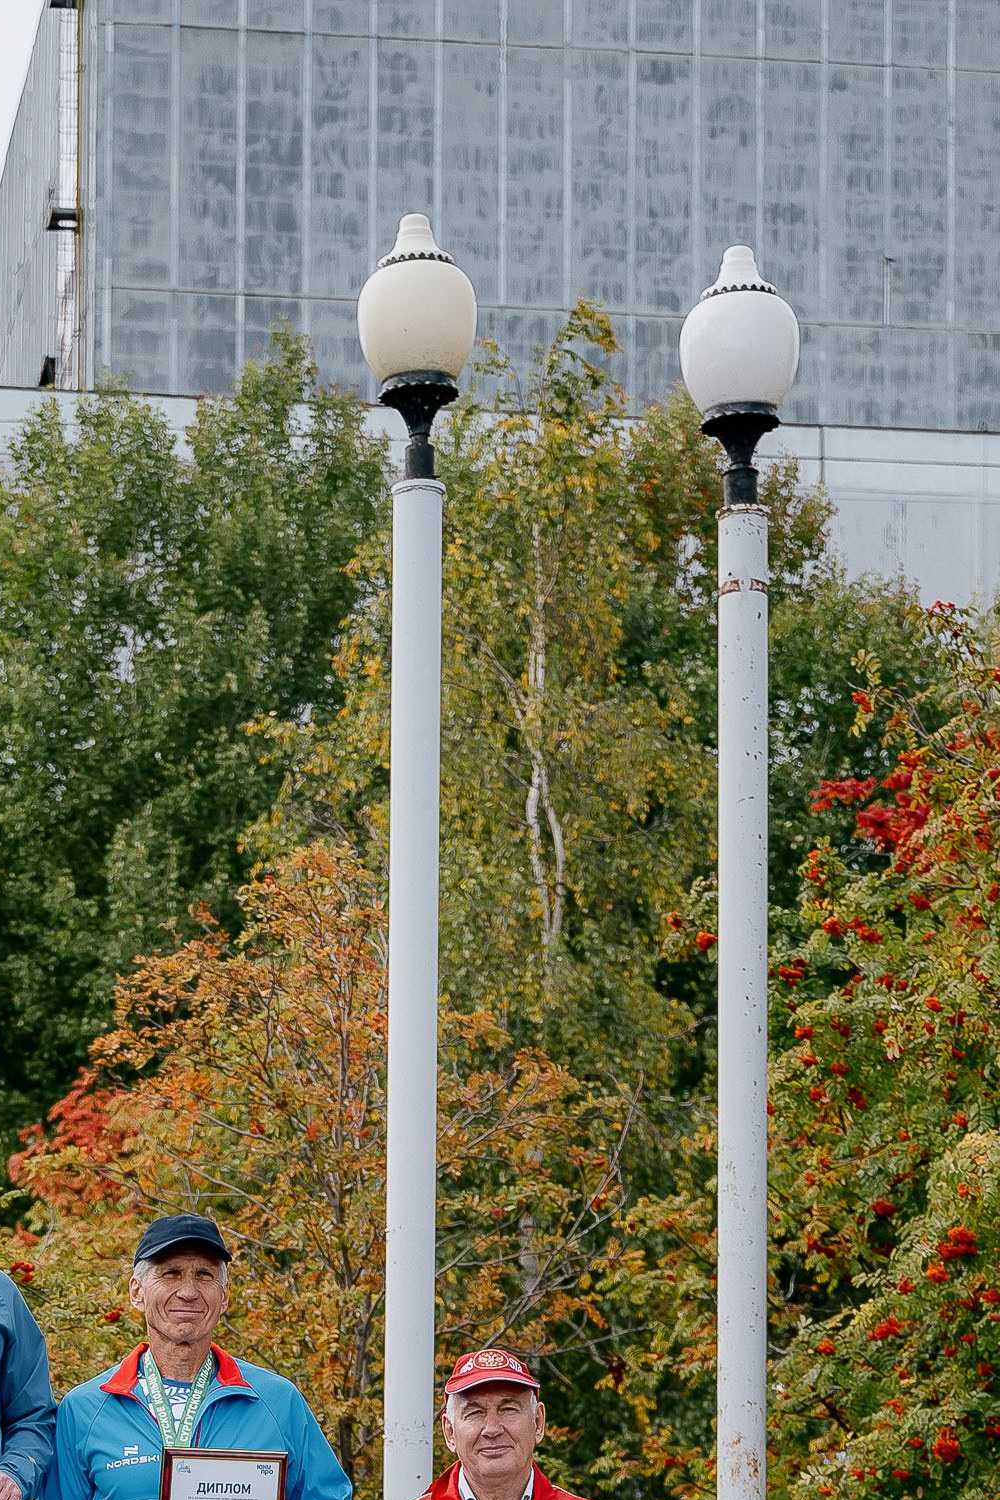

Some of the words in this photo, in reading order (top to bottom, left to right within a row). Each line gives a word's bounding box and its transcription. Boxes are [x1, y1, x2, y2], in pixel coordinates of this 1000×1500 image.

[179, 1388, 203, 1442] СУРГУТСКОЕ
[106, 1454, 160, 1470] NORDSKI
[196, 1482, 252, 1495] ДИПЛОМ
